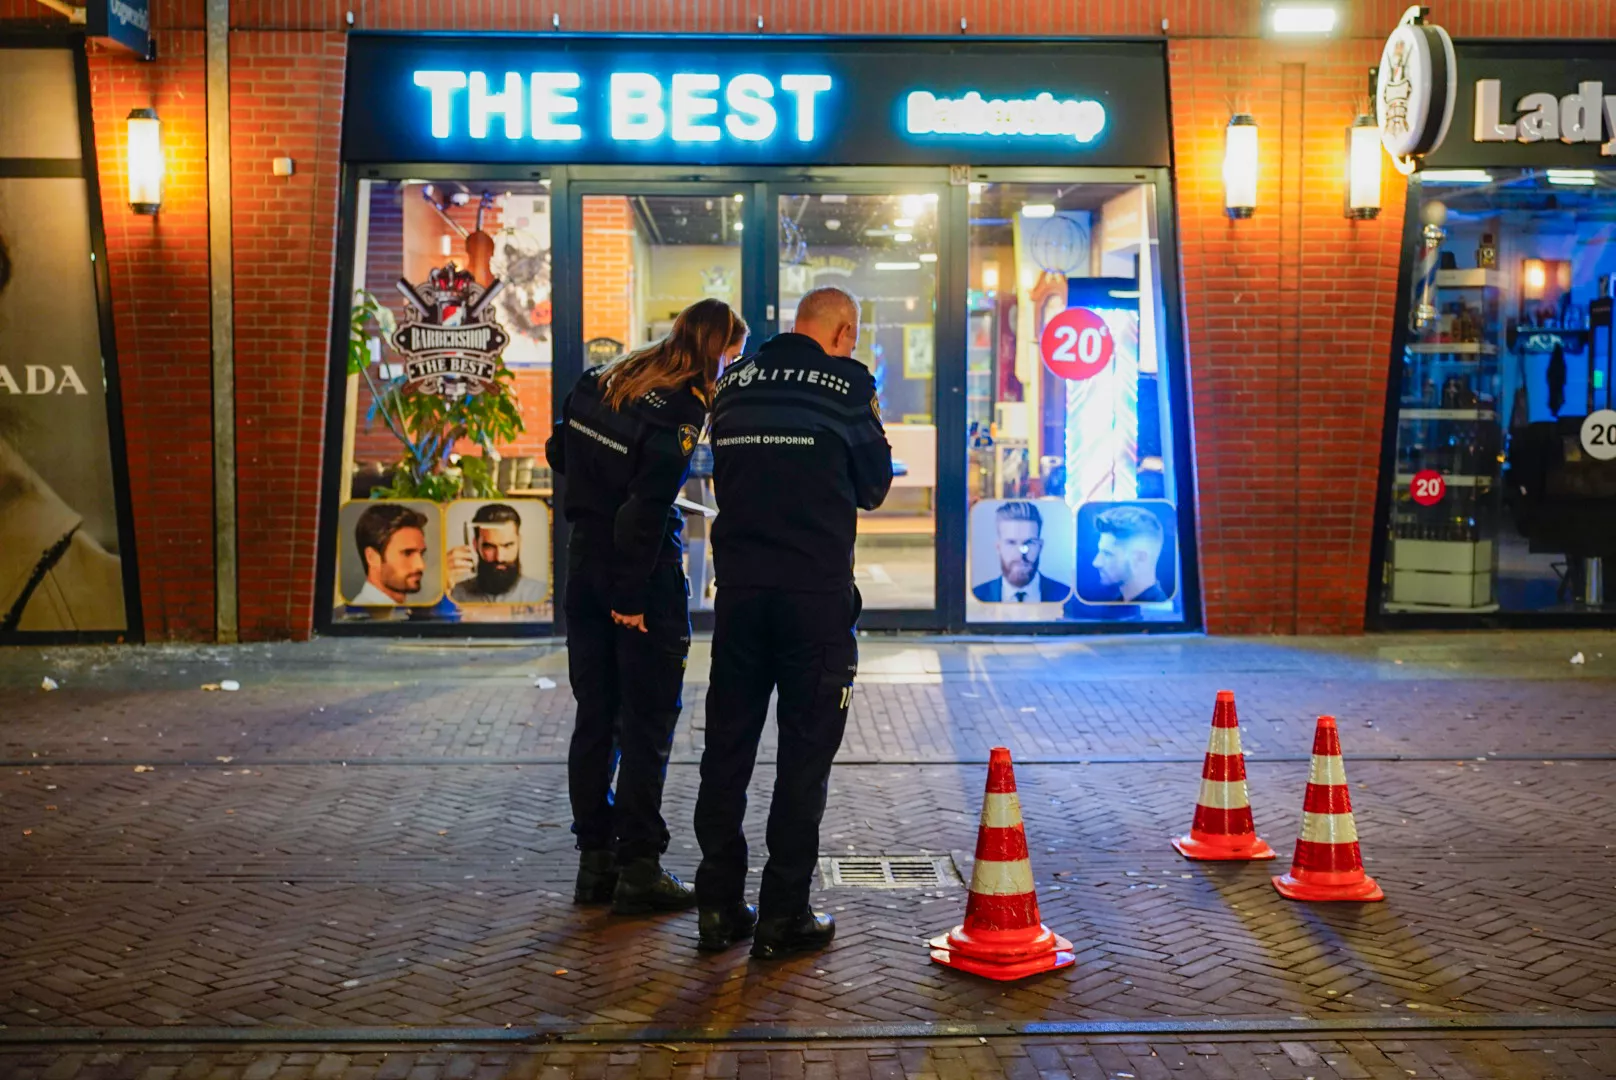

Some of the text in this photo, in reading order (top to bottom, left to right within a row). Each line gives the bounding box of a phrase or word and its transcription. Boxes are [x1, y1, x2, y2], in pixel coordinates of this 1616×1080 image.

[413, 70, 832, 142] THE BEST
[411, 327, 491, 351] BARBERSHOP
[415, 358, 486, 376] THE BEST
[716, 435, 815, 447] FORENSISCHE OPSPORING
